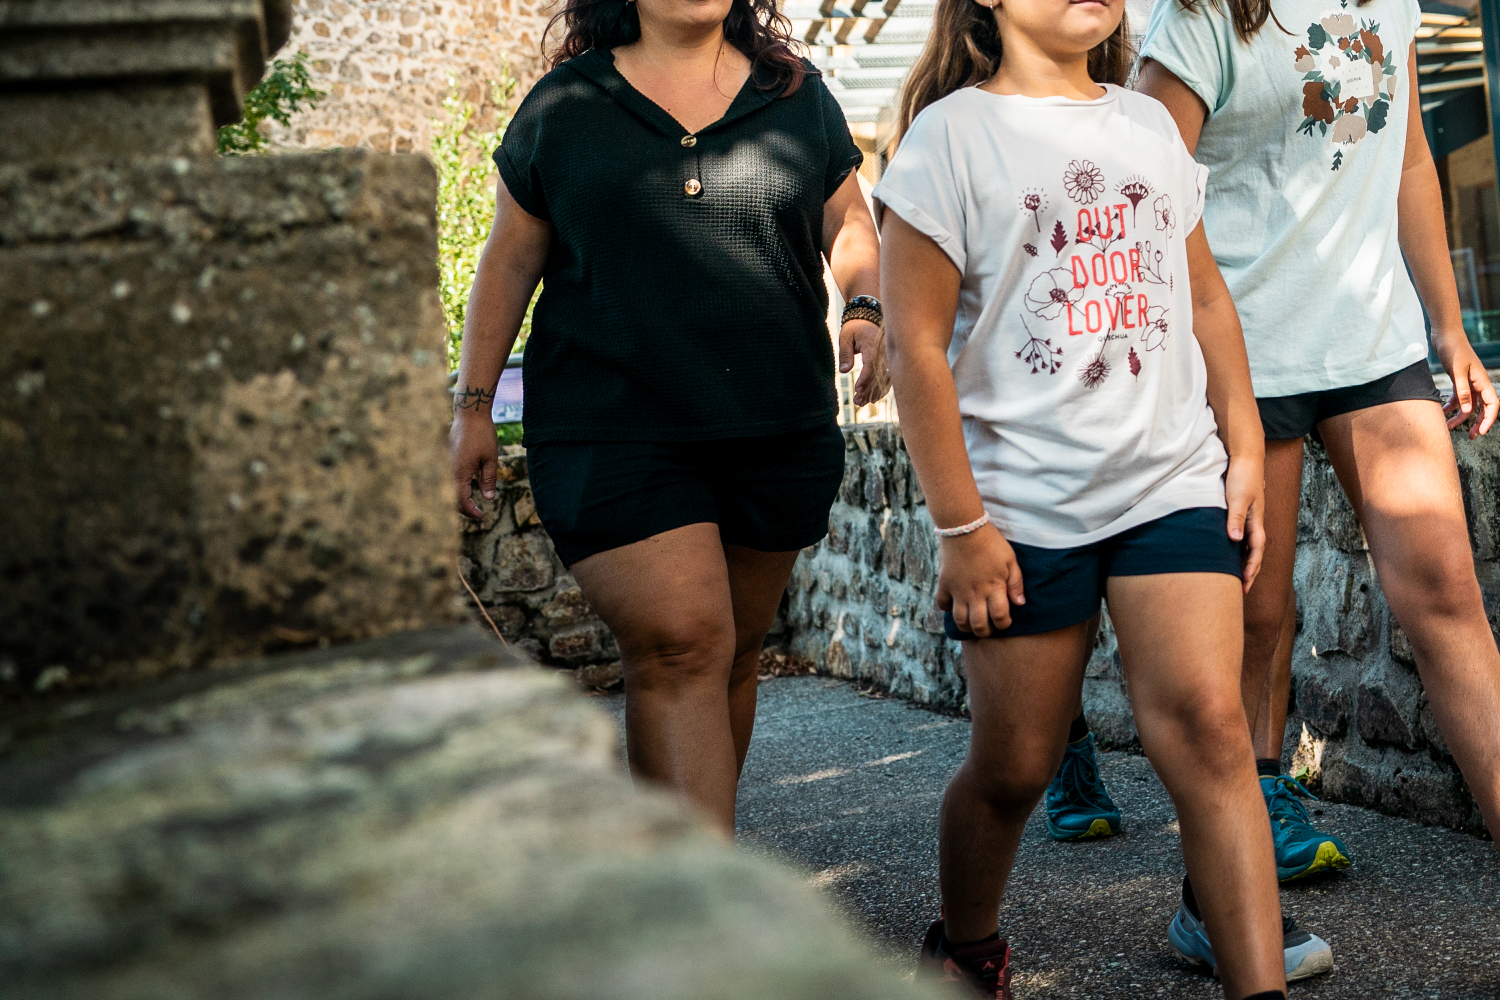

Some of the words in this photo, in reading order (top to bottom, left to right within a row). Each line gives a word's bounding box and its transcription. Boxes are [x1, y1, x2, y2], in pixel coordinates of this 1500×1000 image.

[1077, 204, 1128, 242] OUT
[1071, 249, 1142, 289] DOOR
[1066, 293, 1150, 336] LOVER
[1098, 333, 1128, 342] QUECHUA
